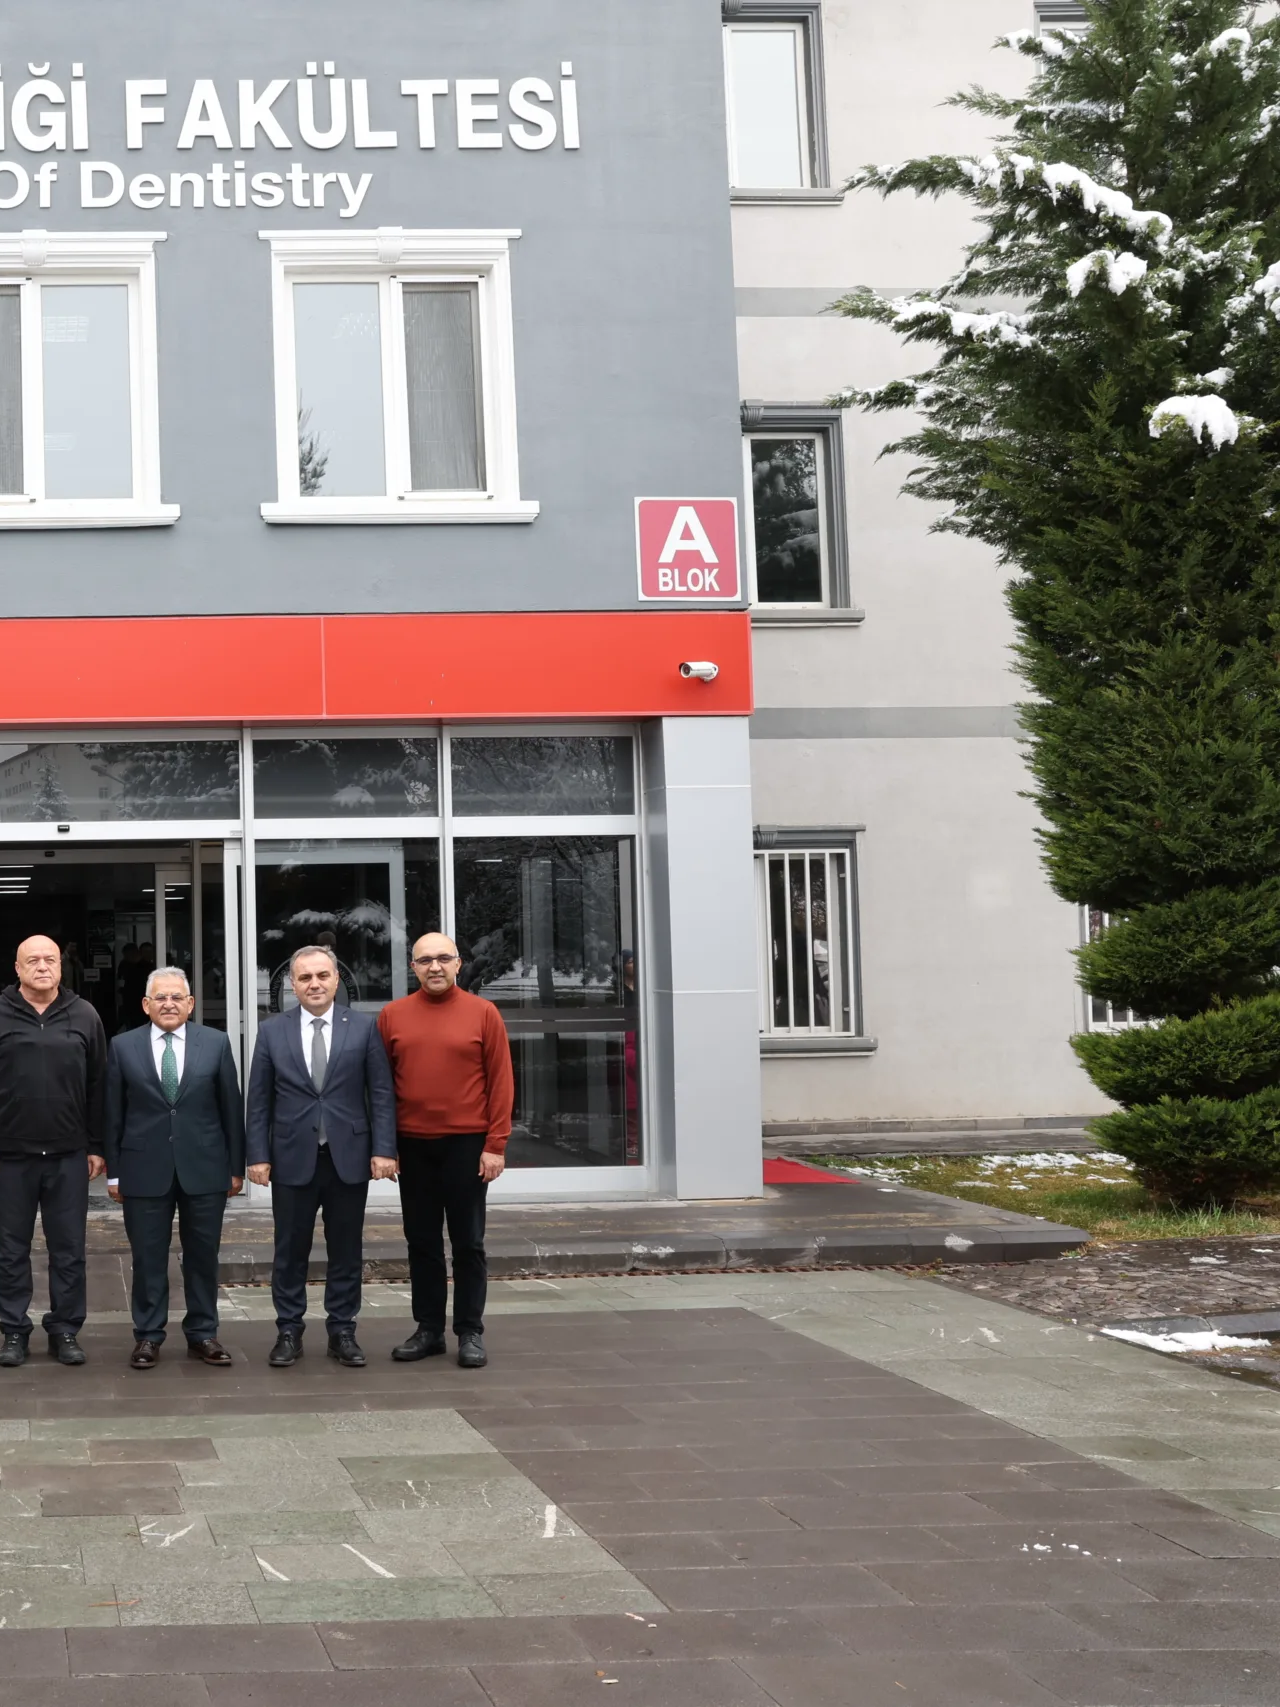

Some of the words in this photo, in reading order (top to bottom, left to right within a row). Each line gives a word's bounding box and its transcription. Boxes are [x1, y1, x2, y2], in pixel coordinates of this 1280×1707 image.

[124, 61, 580, 150] FAKÜLTESİ
[80, 161, 373, 218] Dentistry
[658, 506, 719, 563] A
[658, 568, 720, 592] BLOK
